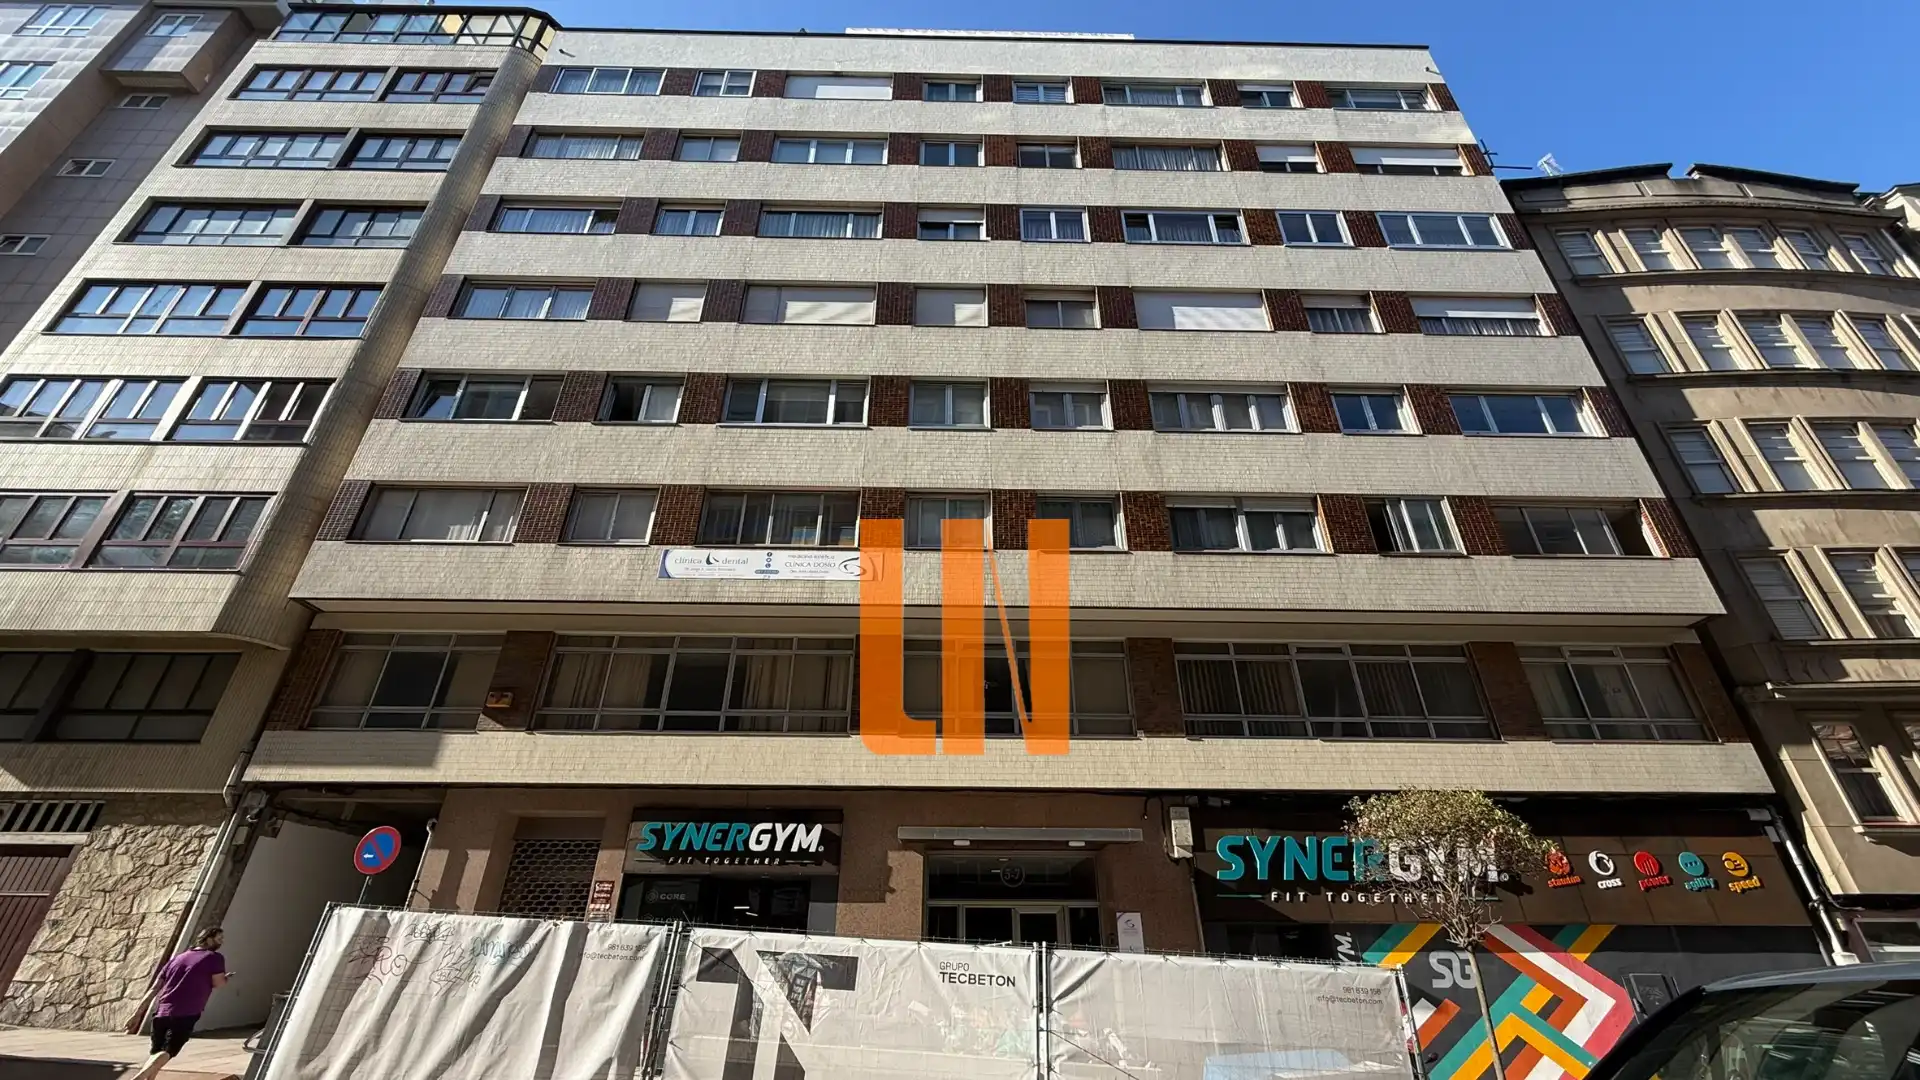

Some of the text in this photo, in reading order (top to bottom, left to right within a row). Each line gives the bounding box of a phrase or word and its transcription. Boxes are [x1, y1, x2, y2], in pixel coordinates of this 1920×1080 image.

[722, 557, 749, 565] dental
[636, 821, 823, 852] SYNERGYM
[668, 856, 780, 865] FIT TOGETHER
[1597, 878, 1622, 889] cross
[1638, 875, 1670, 891] power
[1684, 876, 1715, 891] agility
[1728, 875, 1760, 893] speed
[1271, 892, 1443, 903] FIT TOGETHER
[939, 961, 970, 972] GRUPO
[1429, 951, 1478, 989] SG
[939, 971, 1016, 988] TECBETON
[1315, 994, 1383, 1005] nfo@tecbeton.com
